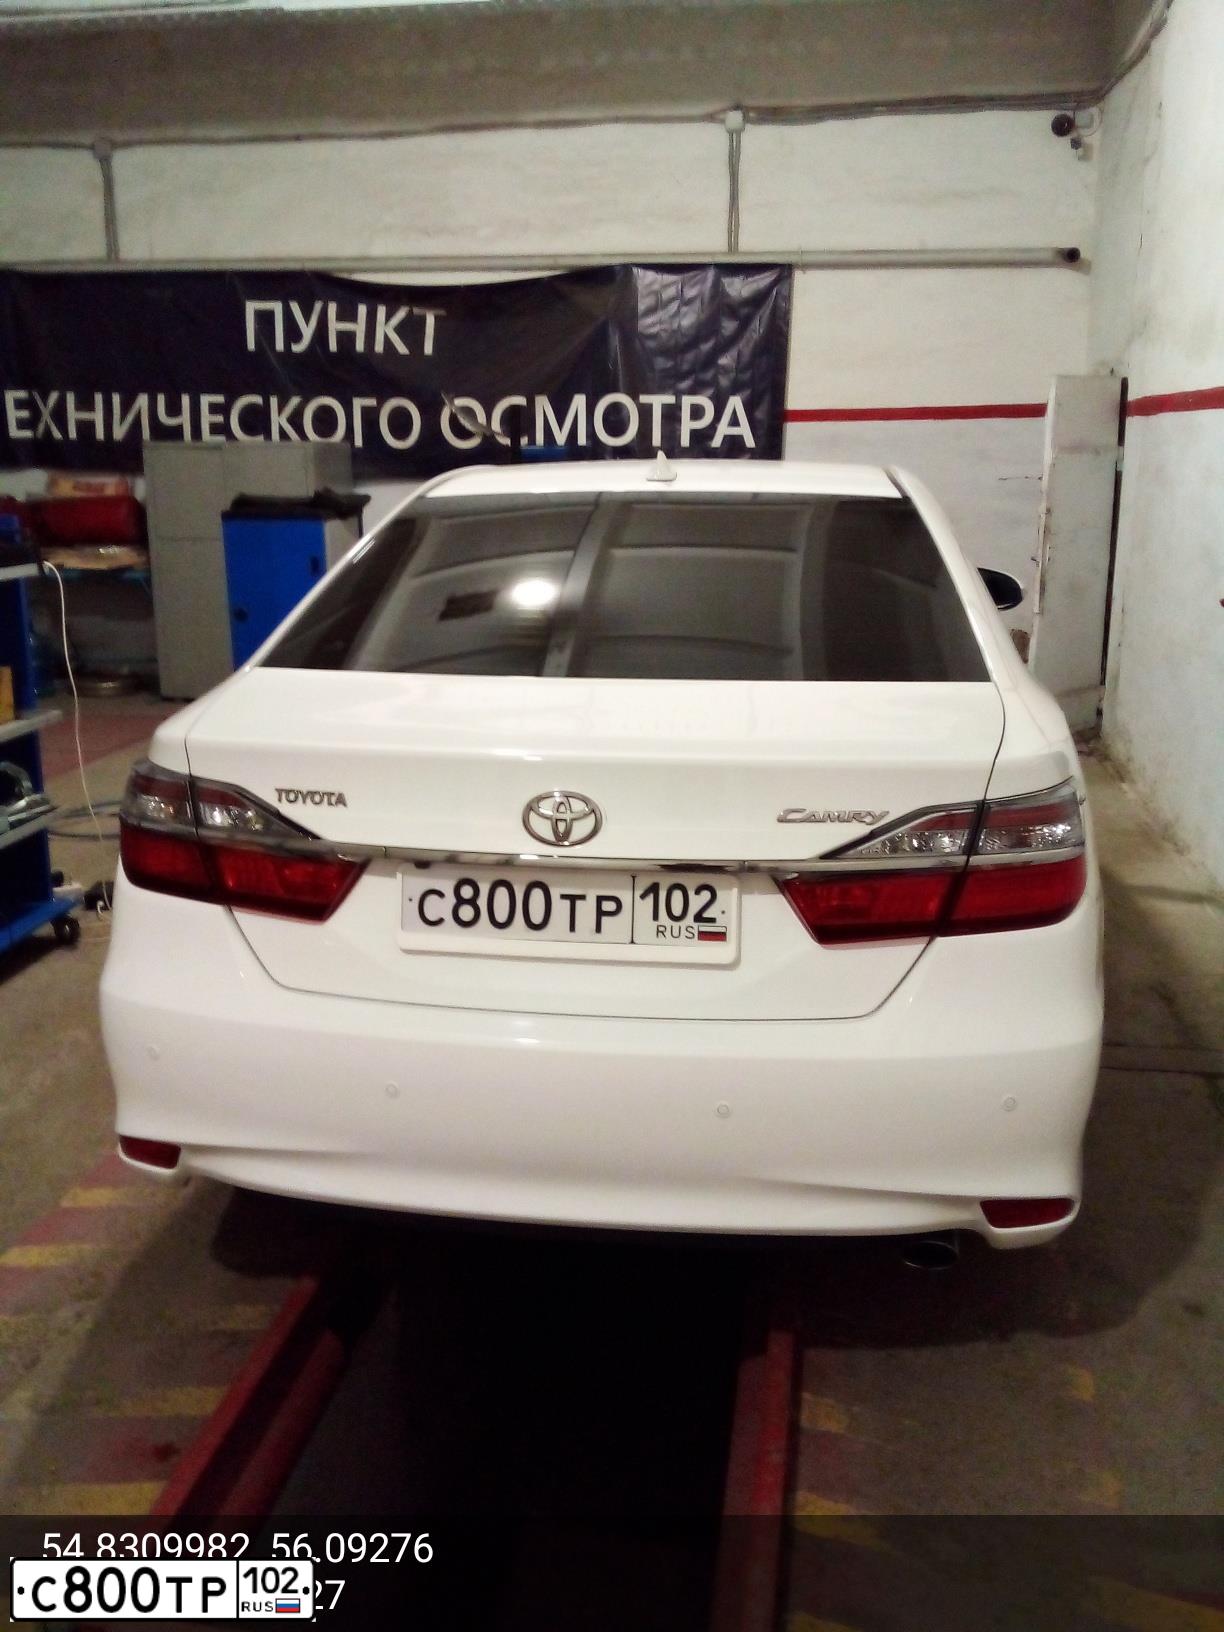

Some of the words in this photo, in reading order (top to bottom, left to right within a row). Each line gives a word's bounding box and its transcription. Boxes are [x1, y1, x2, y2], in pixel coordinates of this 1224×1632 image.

[245, 300, 447, 356] ПУНКТ
[440, 393, 756, 450] ОСМОТРА
[275, 788, 347, 808] TOYOTA
[639, 881, 718, 924] 102
[655, 924, 696, 940] RUS
